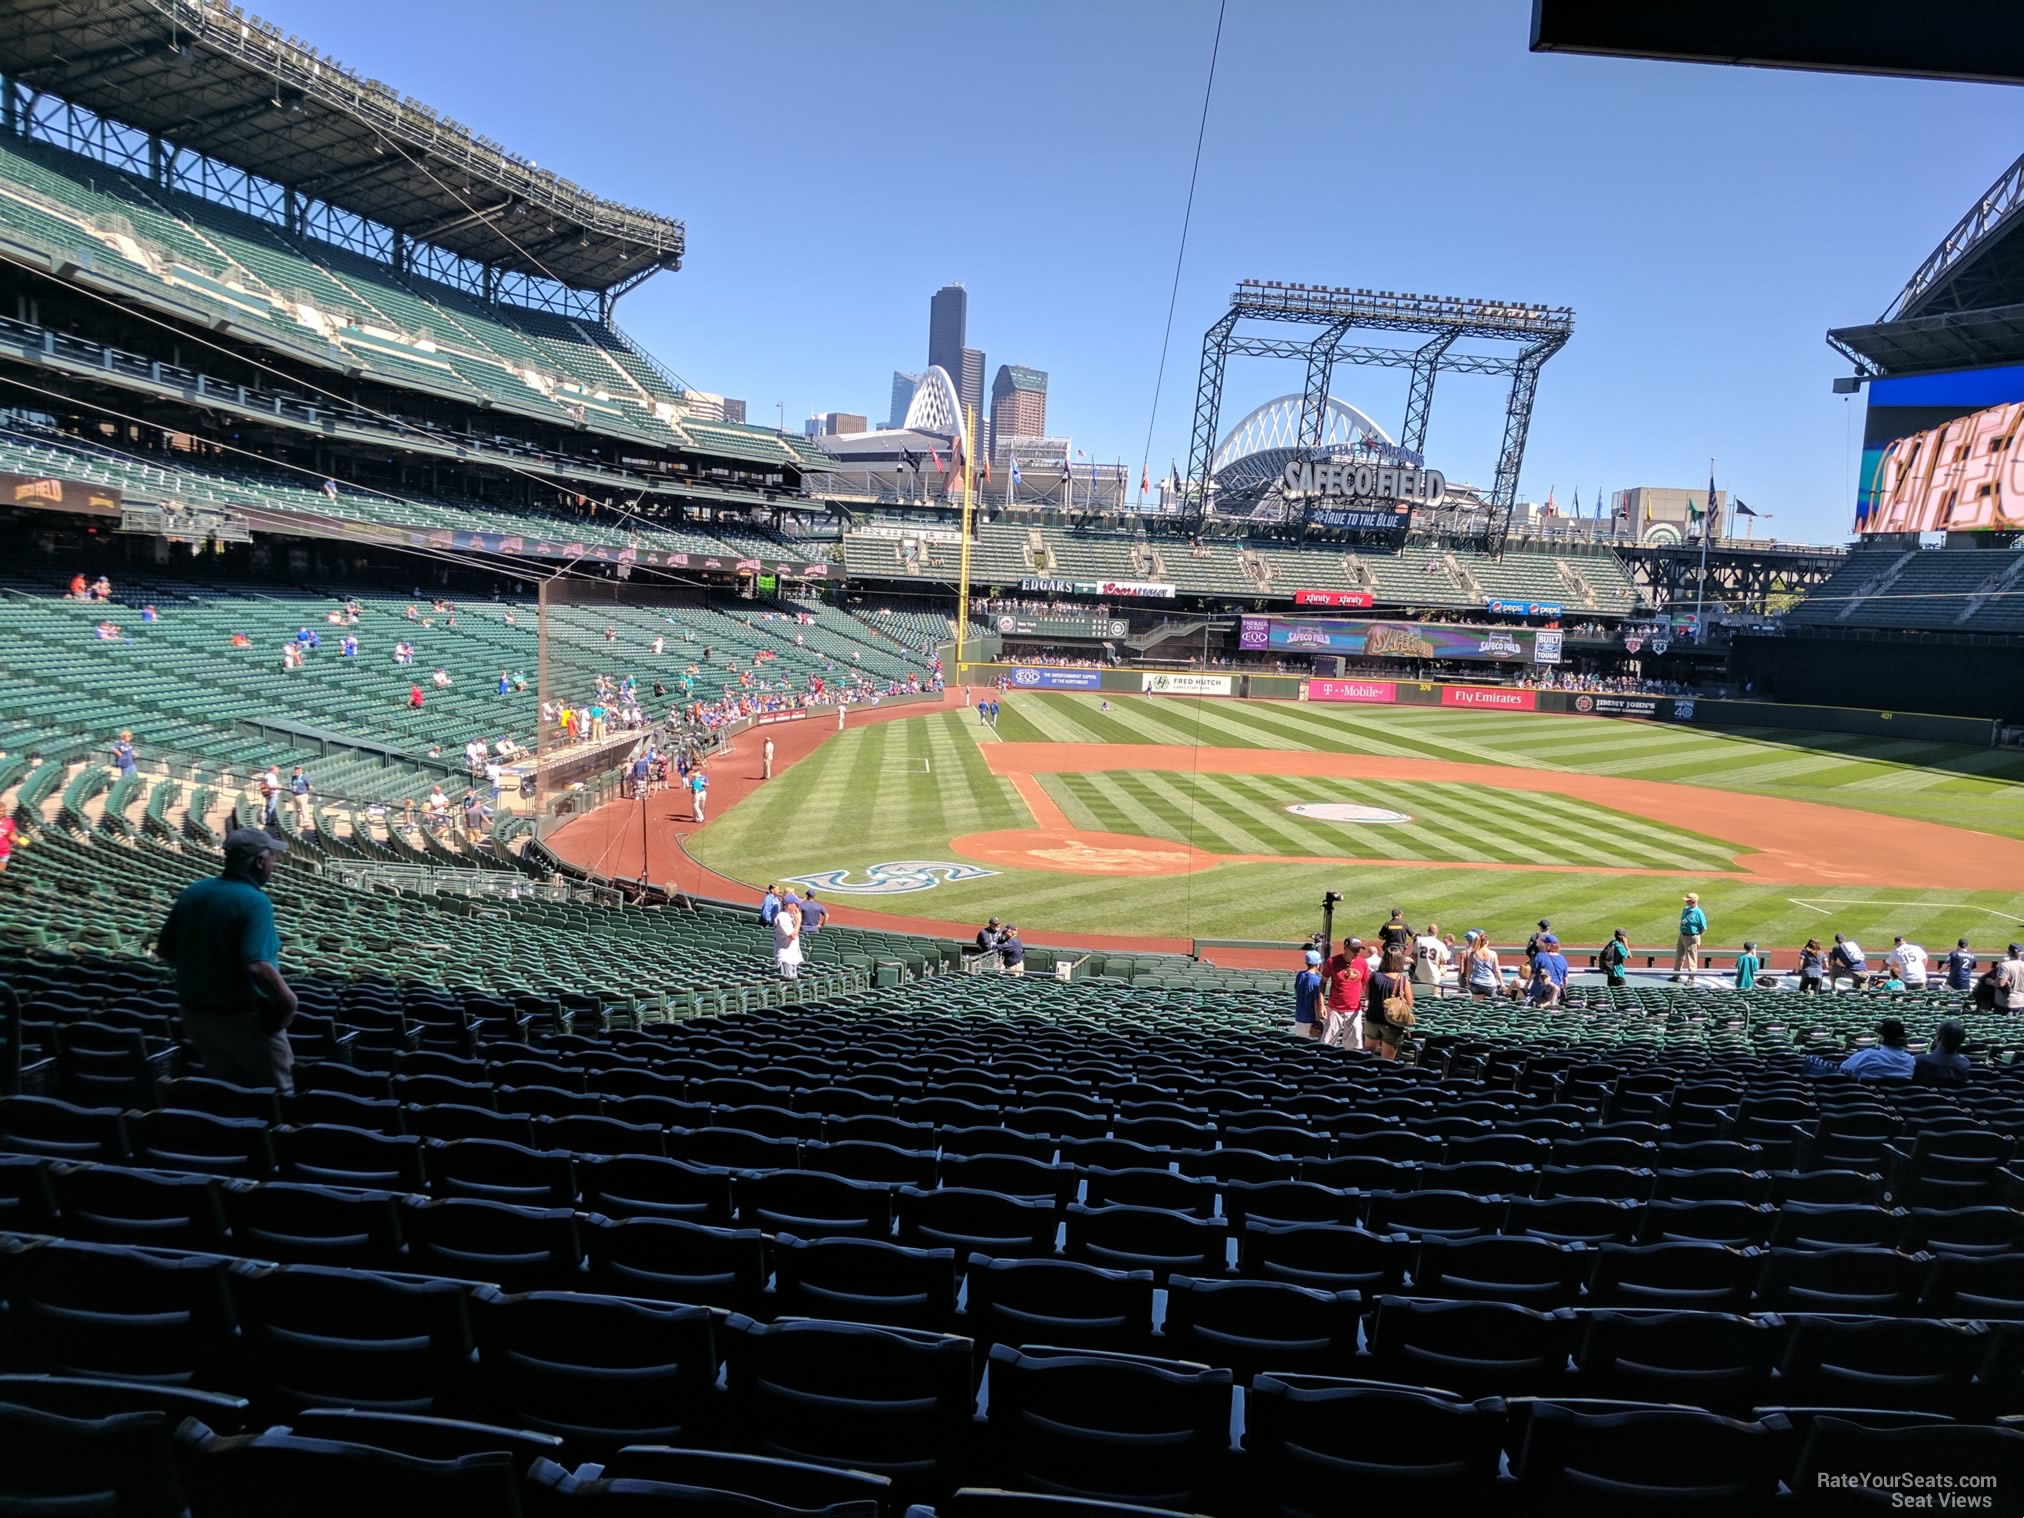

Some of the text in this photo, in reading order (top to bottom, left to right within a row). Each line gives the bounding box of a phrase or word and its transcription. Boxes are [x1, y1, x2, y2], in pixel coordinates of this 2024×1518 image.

[1282, 461, 1446, 508] SAFECO FIELD
[1323, 509, 1399, 527] TRUE TO THE BLUE
[1021, 579, 1072, 593] EDGARS
[1103, 583, 1137, 597] Coors
[1306, 594, 1330, 605] xfinity
[1339, 595, 1363, 606] xfinity
[1503, 604, 1523, 613] pepsi
[1540, 606, 1560, 615] pepsi
[1287, 632, 1330, 645] SAFECO FIELD
[1538, 635, 1559, 644] BUILT
[1479, 641, 1520, 653] SAFECO FIELD
[1655, 643, 1664, 651] 24
[1196, 678, 1221, 686] HUTCH
[1455, 690, 1522, 704] Fly Emirates
[1596, 699, 1656, 709] JIMMY JOHN'S
[1880, 712, 1893, 720] 401
[1420, 946, 1437, 960] 23
[1904, 952, 1916, 963] 15
[1961, 958, 1970, 968] 2
